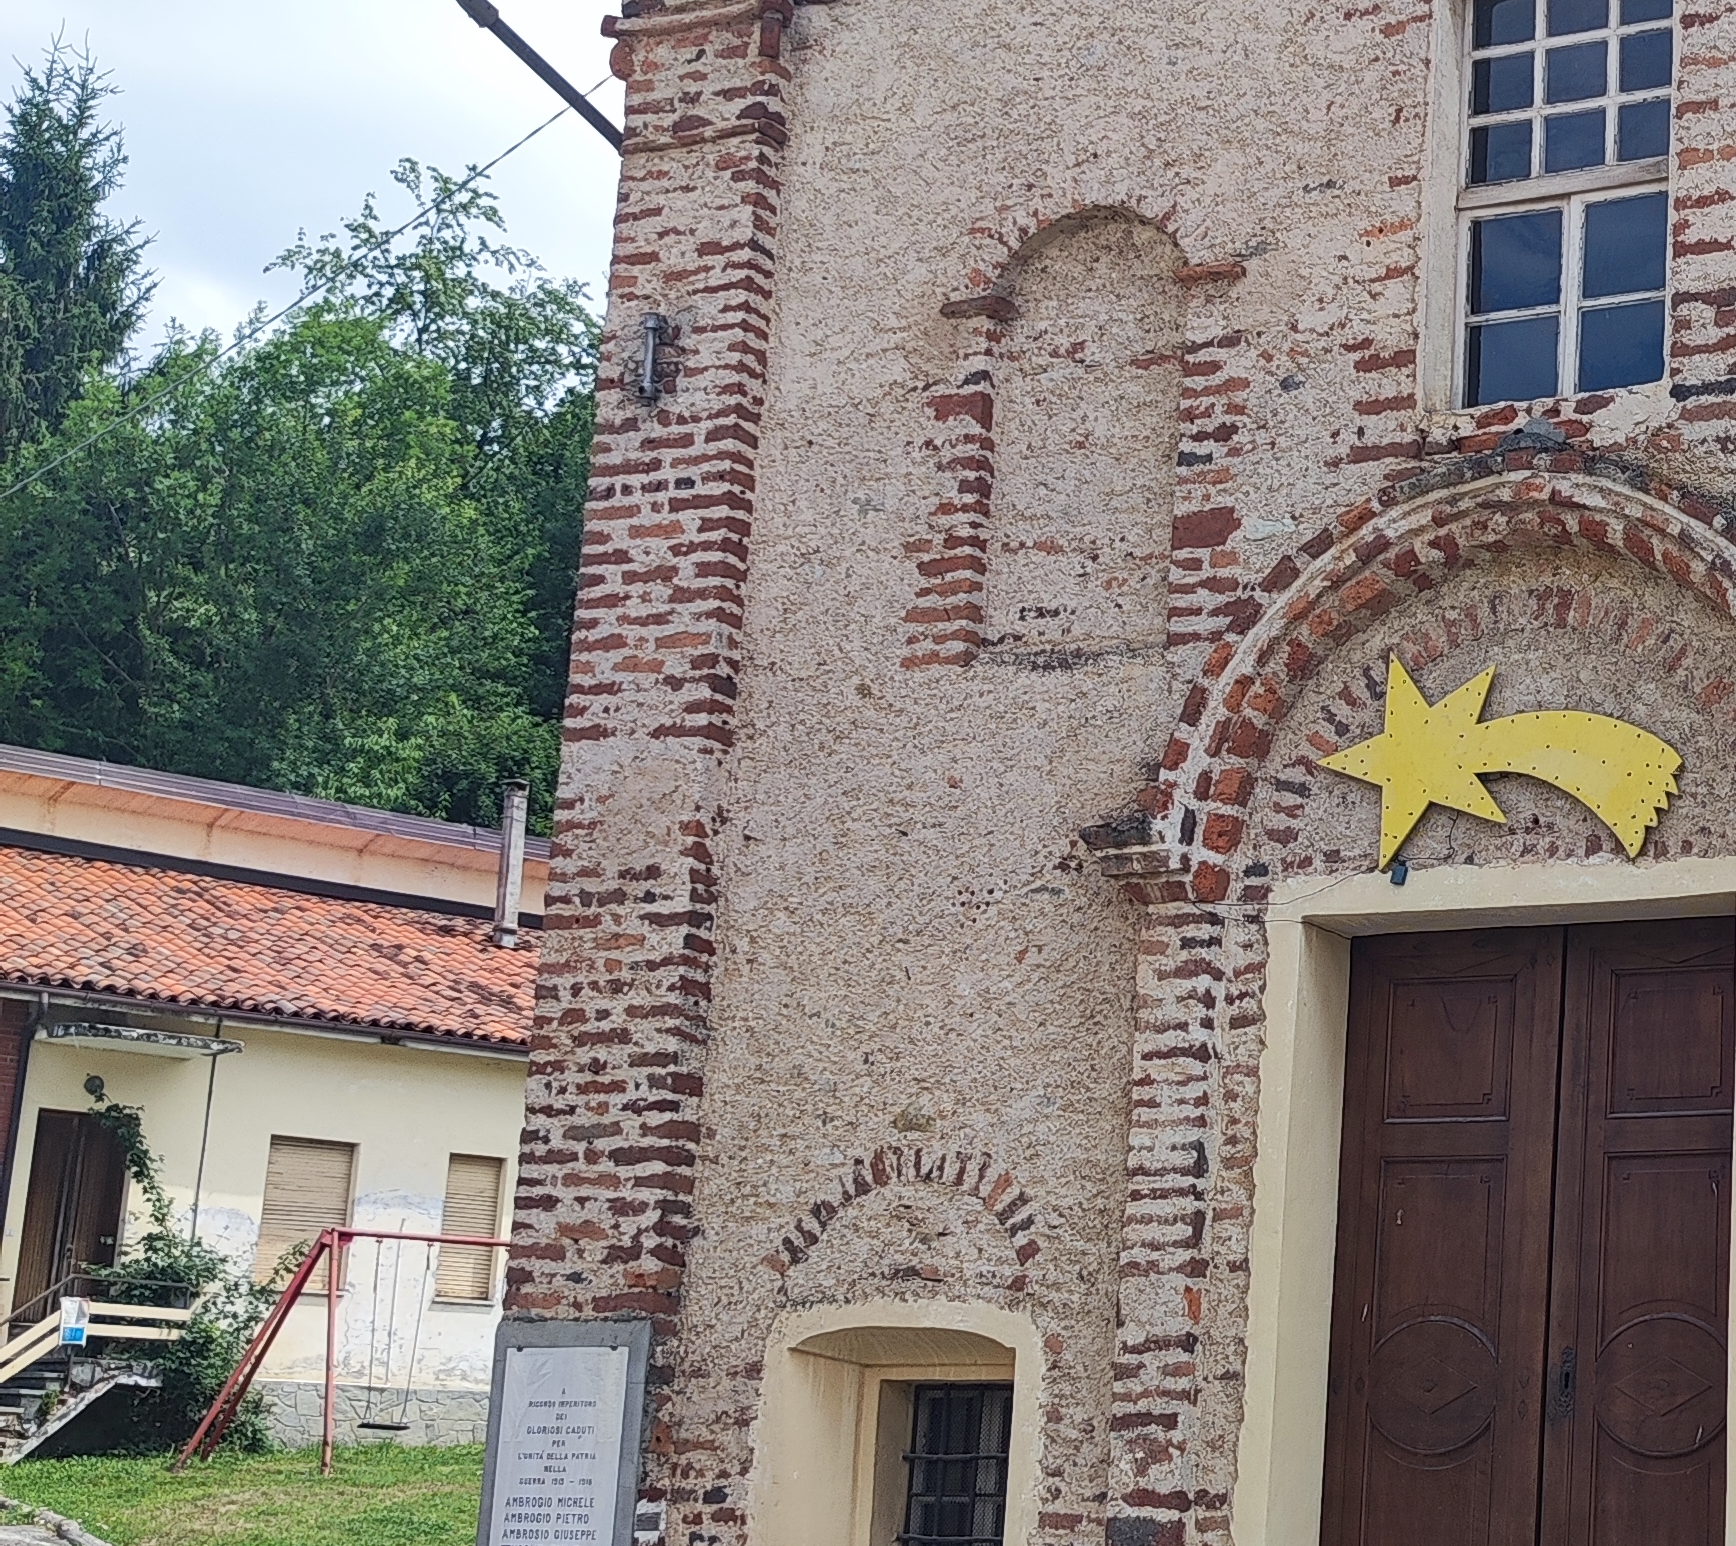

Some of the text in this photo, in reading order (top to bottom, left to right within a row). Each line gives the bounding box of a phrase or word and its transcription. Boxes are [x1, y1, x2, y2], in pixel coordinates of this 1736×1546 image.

[526, 1425, 595, 1435] GLORIOSI CADUTI
[551, 1439, 566, 1448] PER
[571, 1452, 597, 1460] PATRIA
[543, 1465, 567, 1473] NELLA
[504, 1496, 595, 1508] AMBROGIO MICHELE
[503, 1512, 590, 1524] AMBROGIO PIETRO
[501, 1528, 597, 1541] AMBROSIO GIUSEPPE
